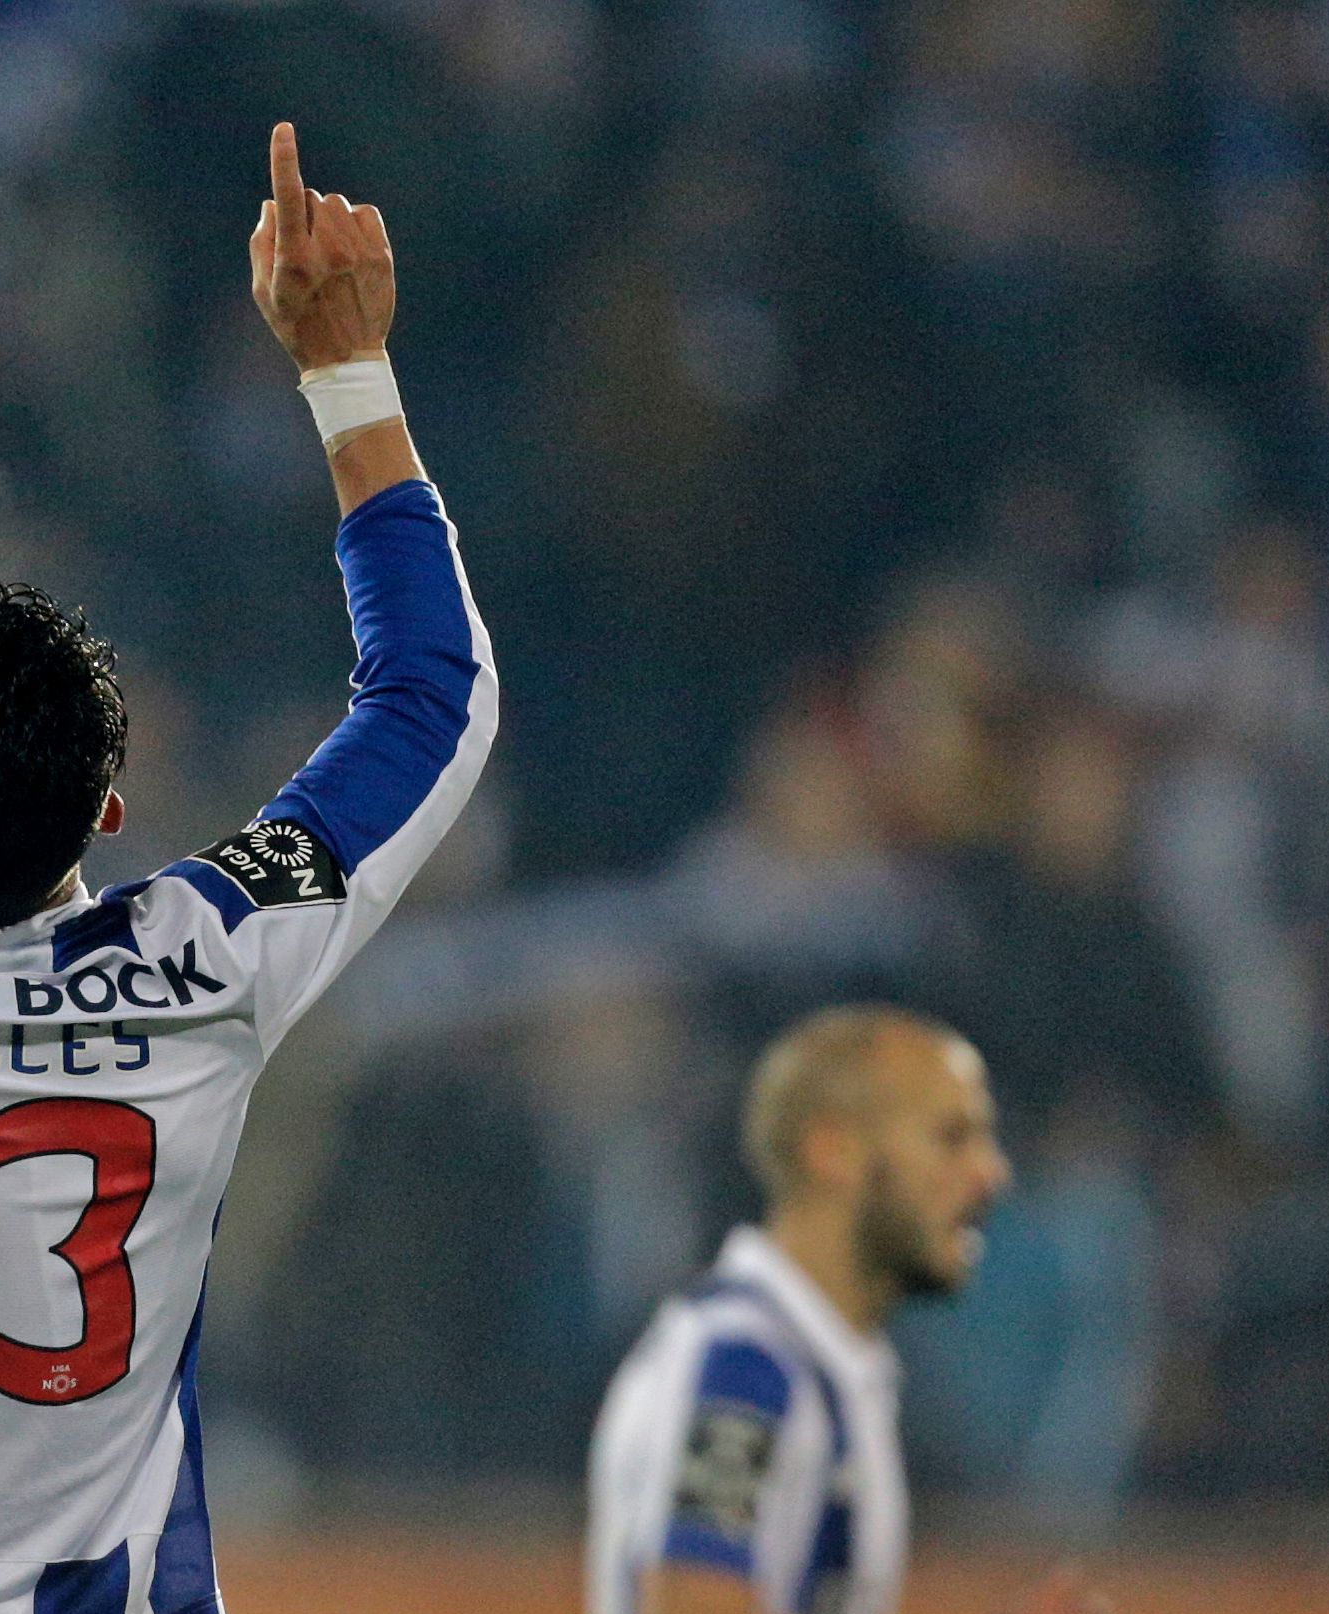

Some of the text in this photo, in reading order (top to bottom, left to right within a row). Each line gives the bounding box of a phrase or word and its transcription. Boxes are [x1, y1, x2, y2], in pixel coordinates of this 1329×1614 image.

[219, 844, 268, 881] LIGA
[13, 937, 228, 1016] BOCK
[51, 1363, 71, 1373] LIGA
